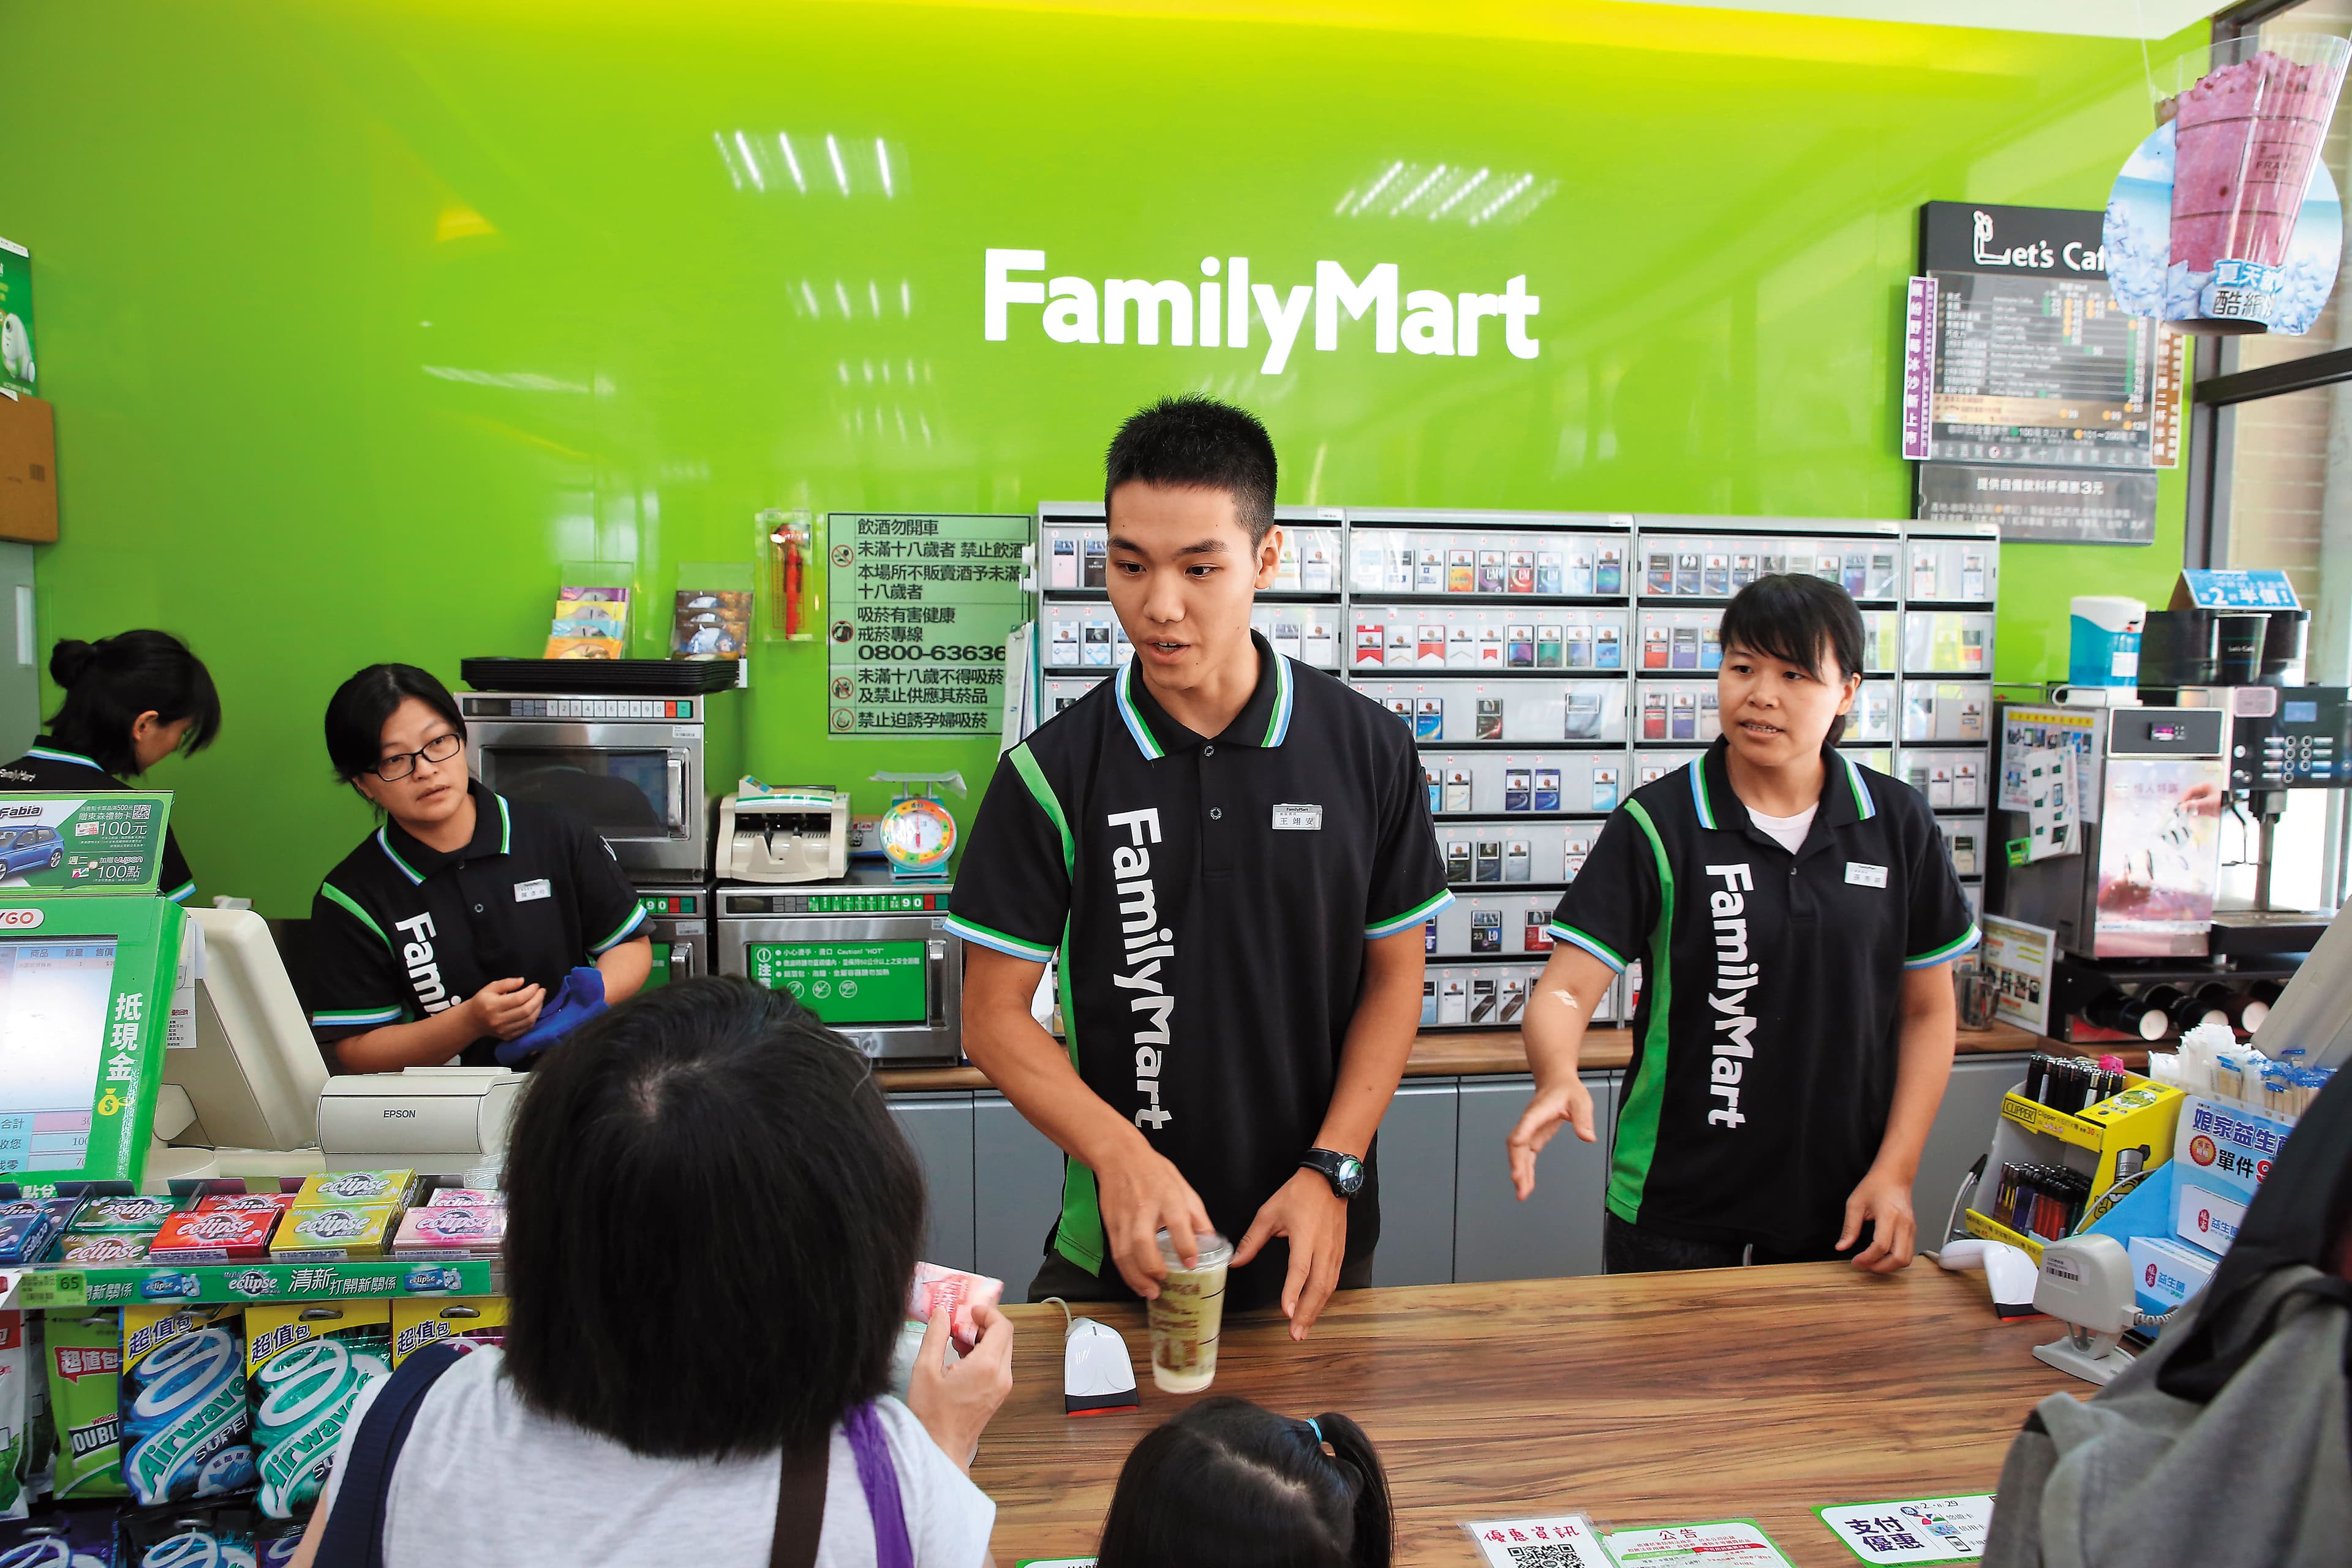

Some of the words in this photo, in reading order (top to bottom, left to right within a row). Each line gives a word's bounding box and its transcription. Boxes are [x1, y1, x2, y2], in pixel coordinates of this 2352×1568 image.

[1973, 210, 2054, 268] Let's
[2062, 242, 2105, 271] Caf
[984, 247, 1540, 375] FamilyMart
[858, 519, 939, 536] 飲酒勿開車
[858, 542, 956, 559] 未滿十八歲者
[961, 542, 1024, 559] 禁止飲酒
[858, 564, 1020, 582] 本場所不販賣酒予未滿
[858, 584, 923, 600] 十八歲者
[858, 606, 956, 624] 吸菸有害健康
[858, 626, 923, 643] 戒菸專線
[859, 645, 1005, 661] 0800-63636
[858, 668, 1003, 685] 未滿十八歲不得吸菸
[858, 688, 987, 704] 及禁止供應其菸品
[858, 712, 987, 728] 禁止迫誘孕婦吸菸
[99, 821, 148, 836] 100元
[98, 865, 142, 878] 100點
[647, 901, 655, 910] 9
[658, 900, 666, 910] 0
[914, 898, 922, 907] 0
[395, 911, 462, 1016] Fami
[1107, 807, 1175, 1129] FamilyMart
[1705, 863, 1759, 1128] FamilyMart
[107, 993, 143, 1081] 抵現金
[383, 1109, 416, 1118] EPSON
[2006, 1102, 2034, 1121] CLIPPER
[2, 1119, 24, 1129] 合計
[317, 1175, 391, 1196] eclipse
[176, 1216, 255, 1238] eclipse
[294, 1213, 371, 1235] eclipse
[416, 1213, 492, 1235] eclipse
[64, 1242, 145, 1262] eclipse
[61, 1276, 80, 1290] 65
[228, 1273, 278, 1294] eclipse
[288, 1267, 339, 1294] 清新
[329, 1276, 398, 1296] 打開新關係
[409, 1274, 436, 1286] eclipse
[127, 1315, 194, 1359] 超值包
[251, 1323, 311, 1365] 超值包
[396, 1319, 451, 1357] 超值包
[60, 1350, 118, 1374] 超值包
[71, 1425, 119, 1454] OUBL
[138, 1366, 246, 1500] Airwave
[1483, 1526, 1580, 1543] 優惠資訊
[1659, 1528, 1698, 1541] 公告
[1844, 1515, 1905, 1536] 支付
[1861, 1532, 1925, 1553] 優惠
